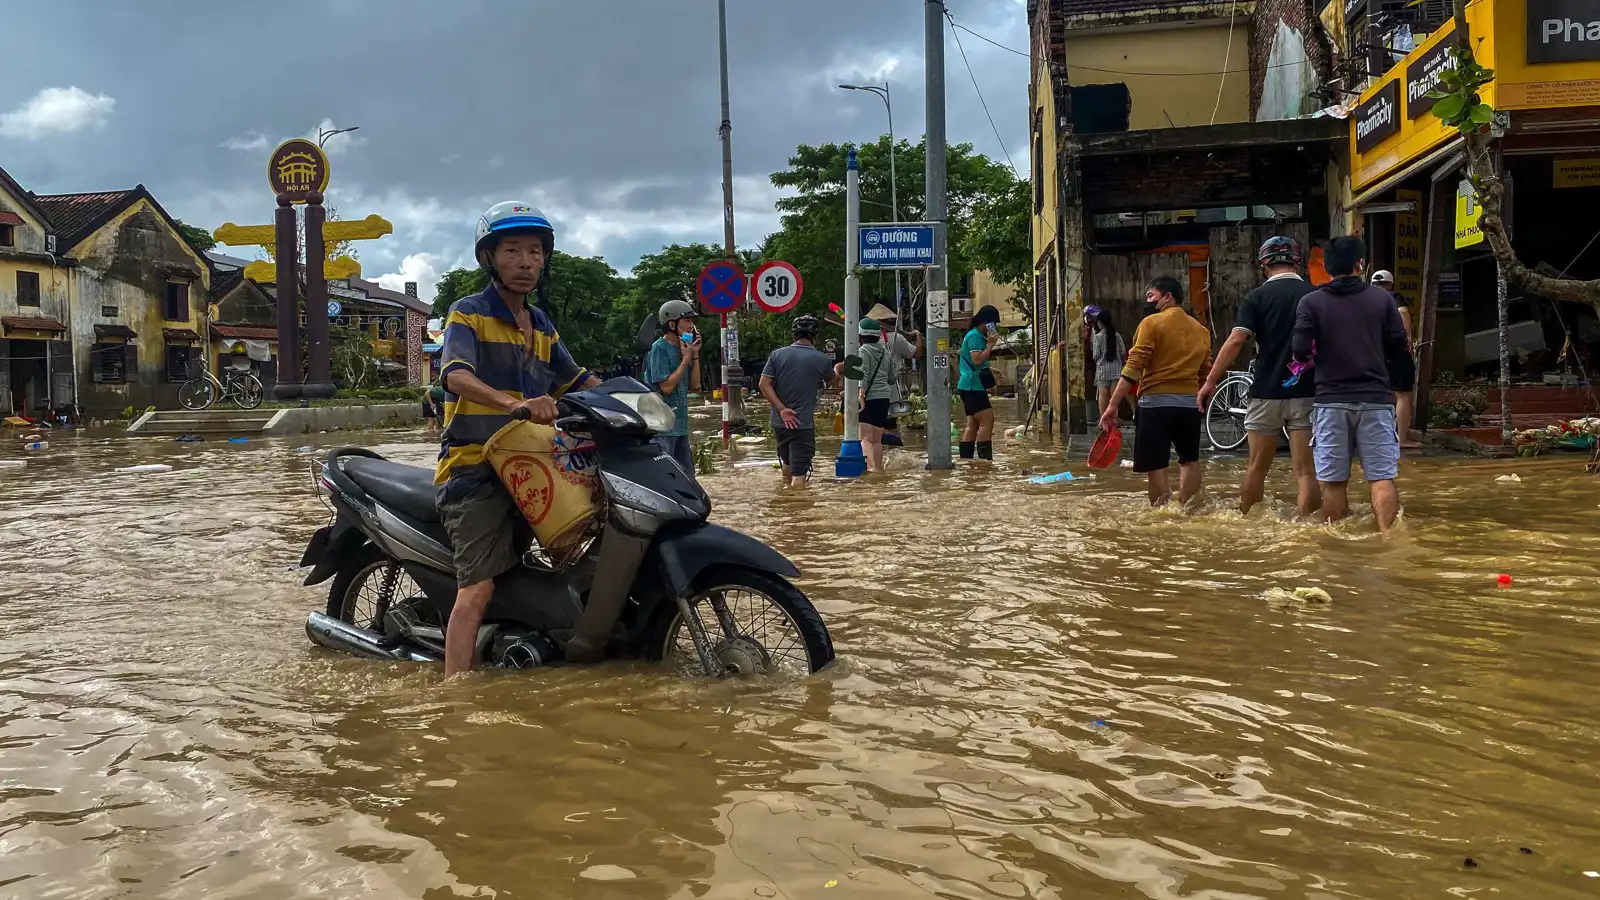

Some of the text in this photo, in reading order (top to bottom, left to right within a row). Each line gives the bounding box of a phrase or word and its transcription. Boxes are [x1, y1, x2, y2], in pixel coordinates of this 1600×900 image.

[1542, 18, 1600, 43] Pha
[1357, 102, 1392, 140] Pharmacity
[286, 184, 298, 192] HỘI
[882, 229, 918, 243] ĐƯỜNG
[863, 245, 932, 260] NGUYỄN THỊ MINH KHAI
[764, 275, 790, 297] 30
